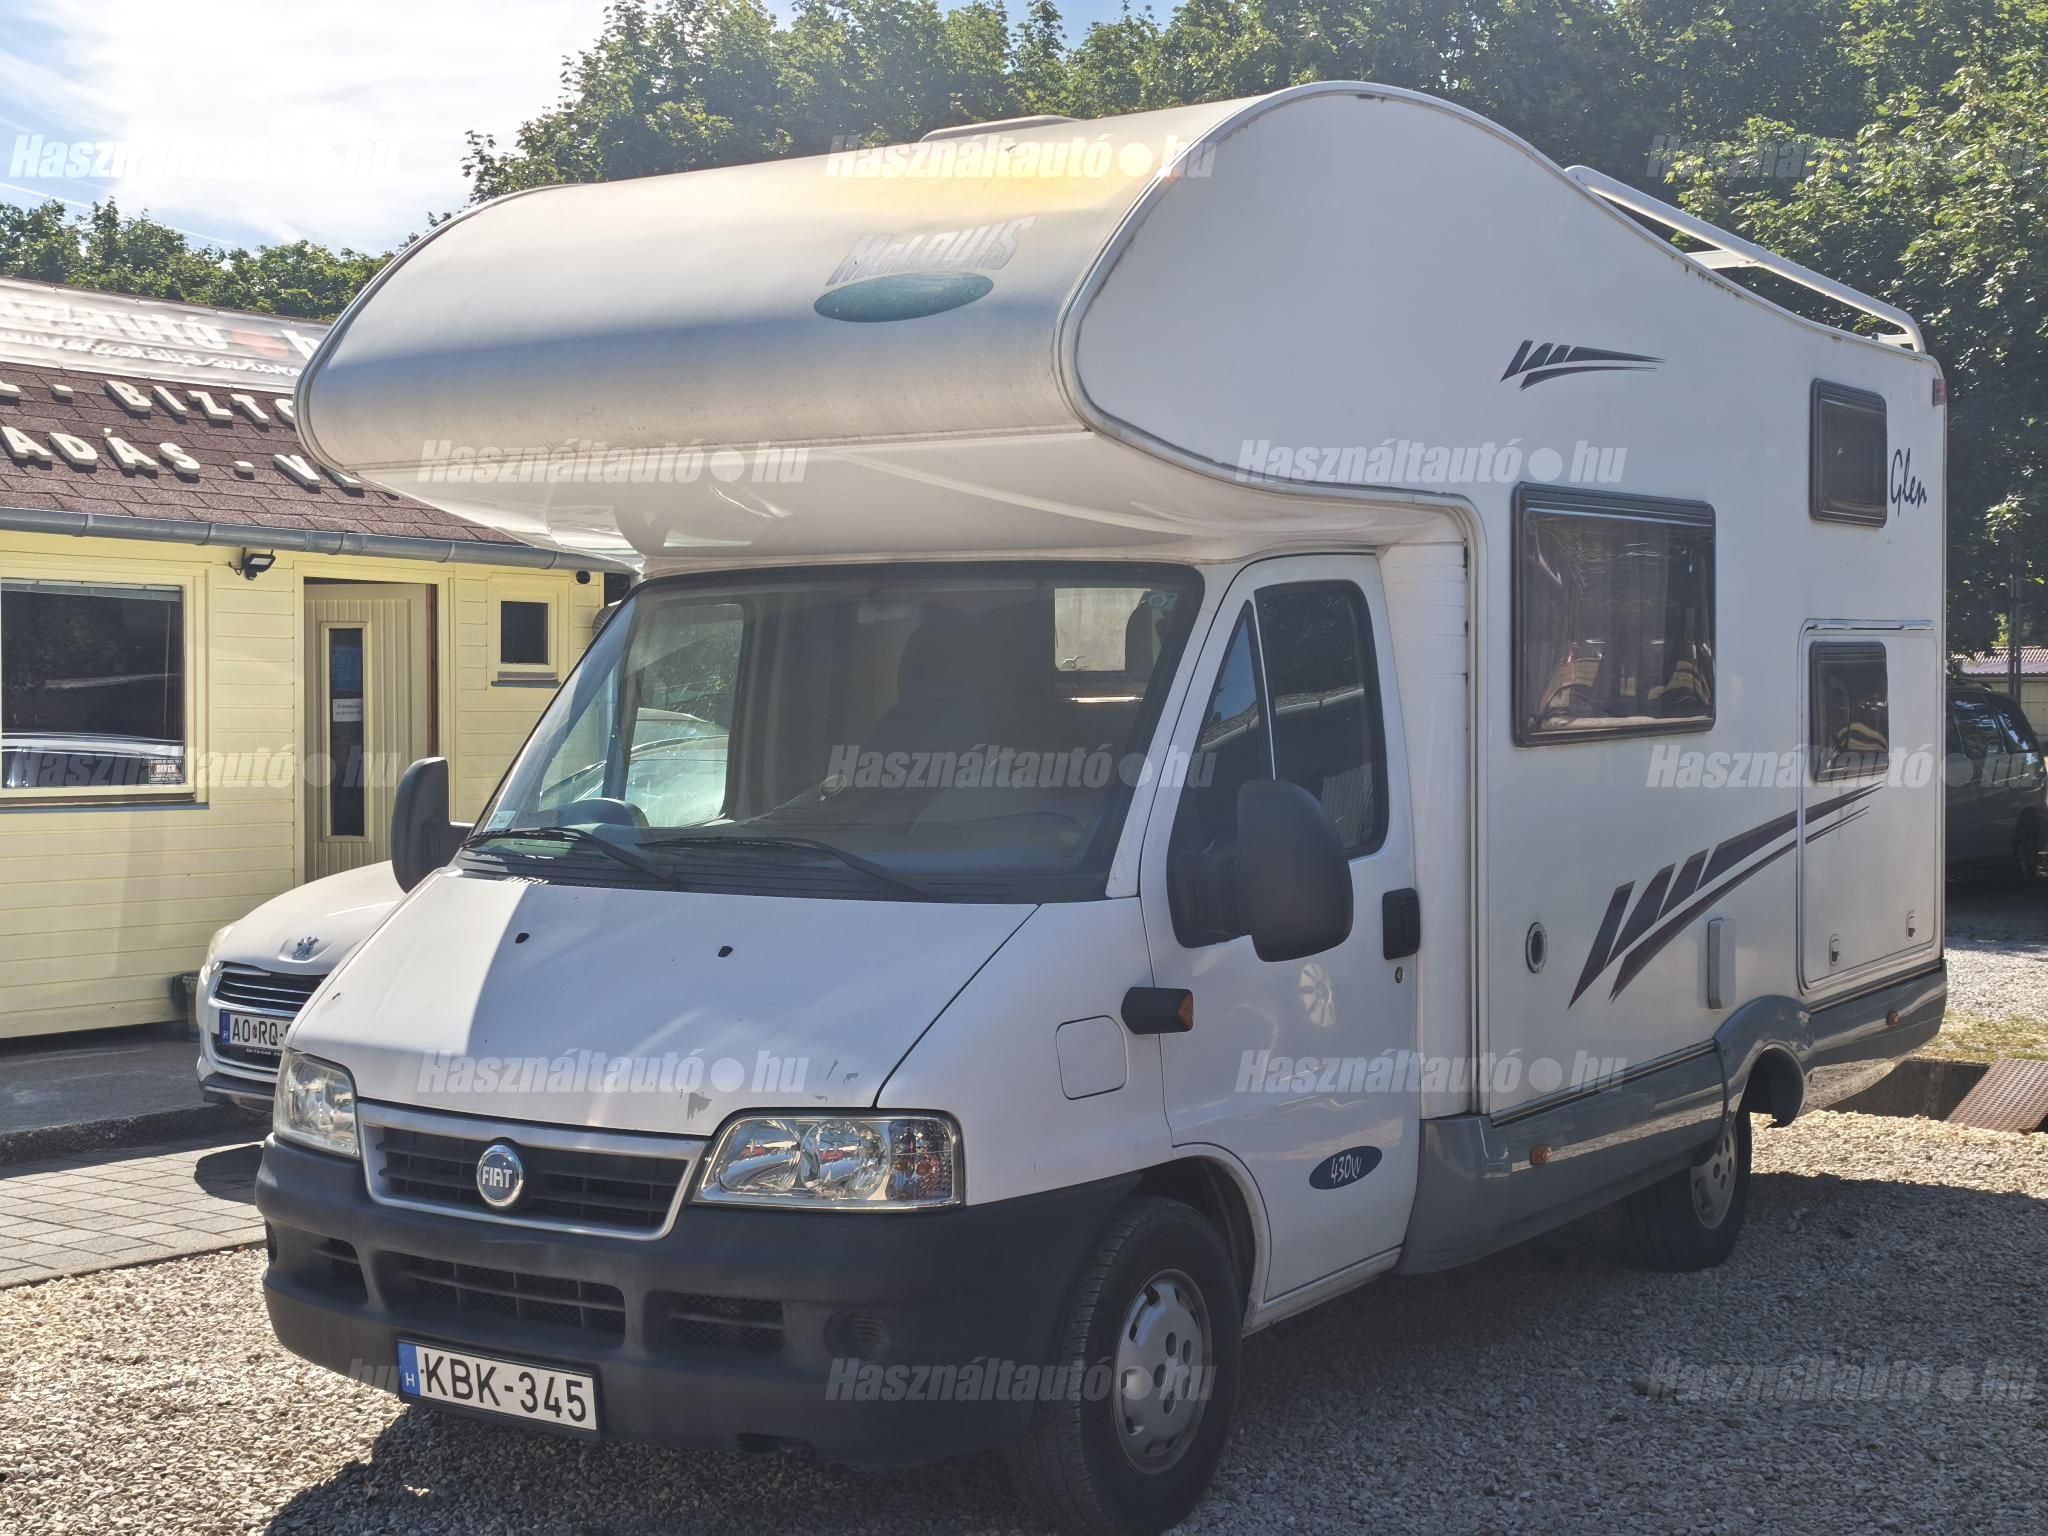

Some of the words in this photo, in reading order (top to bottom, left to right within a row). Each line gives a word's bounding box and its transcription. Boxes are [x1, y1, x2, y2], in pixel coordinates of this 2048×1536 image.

[1890, 447, 1928, 519] Glen
[481, 1166, 513, 1189] FIAT
[422, 1351, 587, 1423] KBK-345
